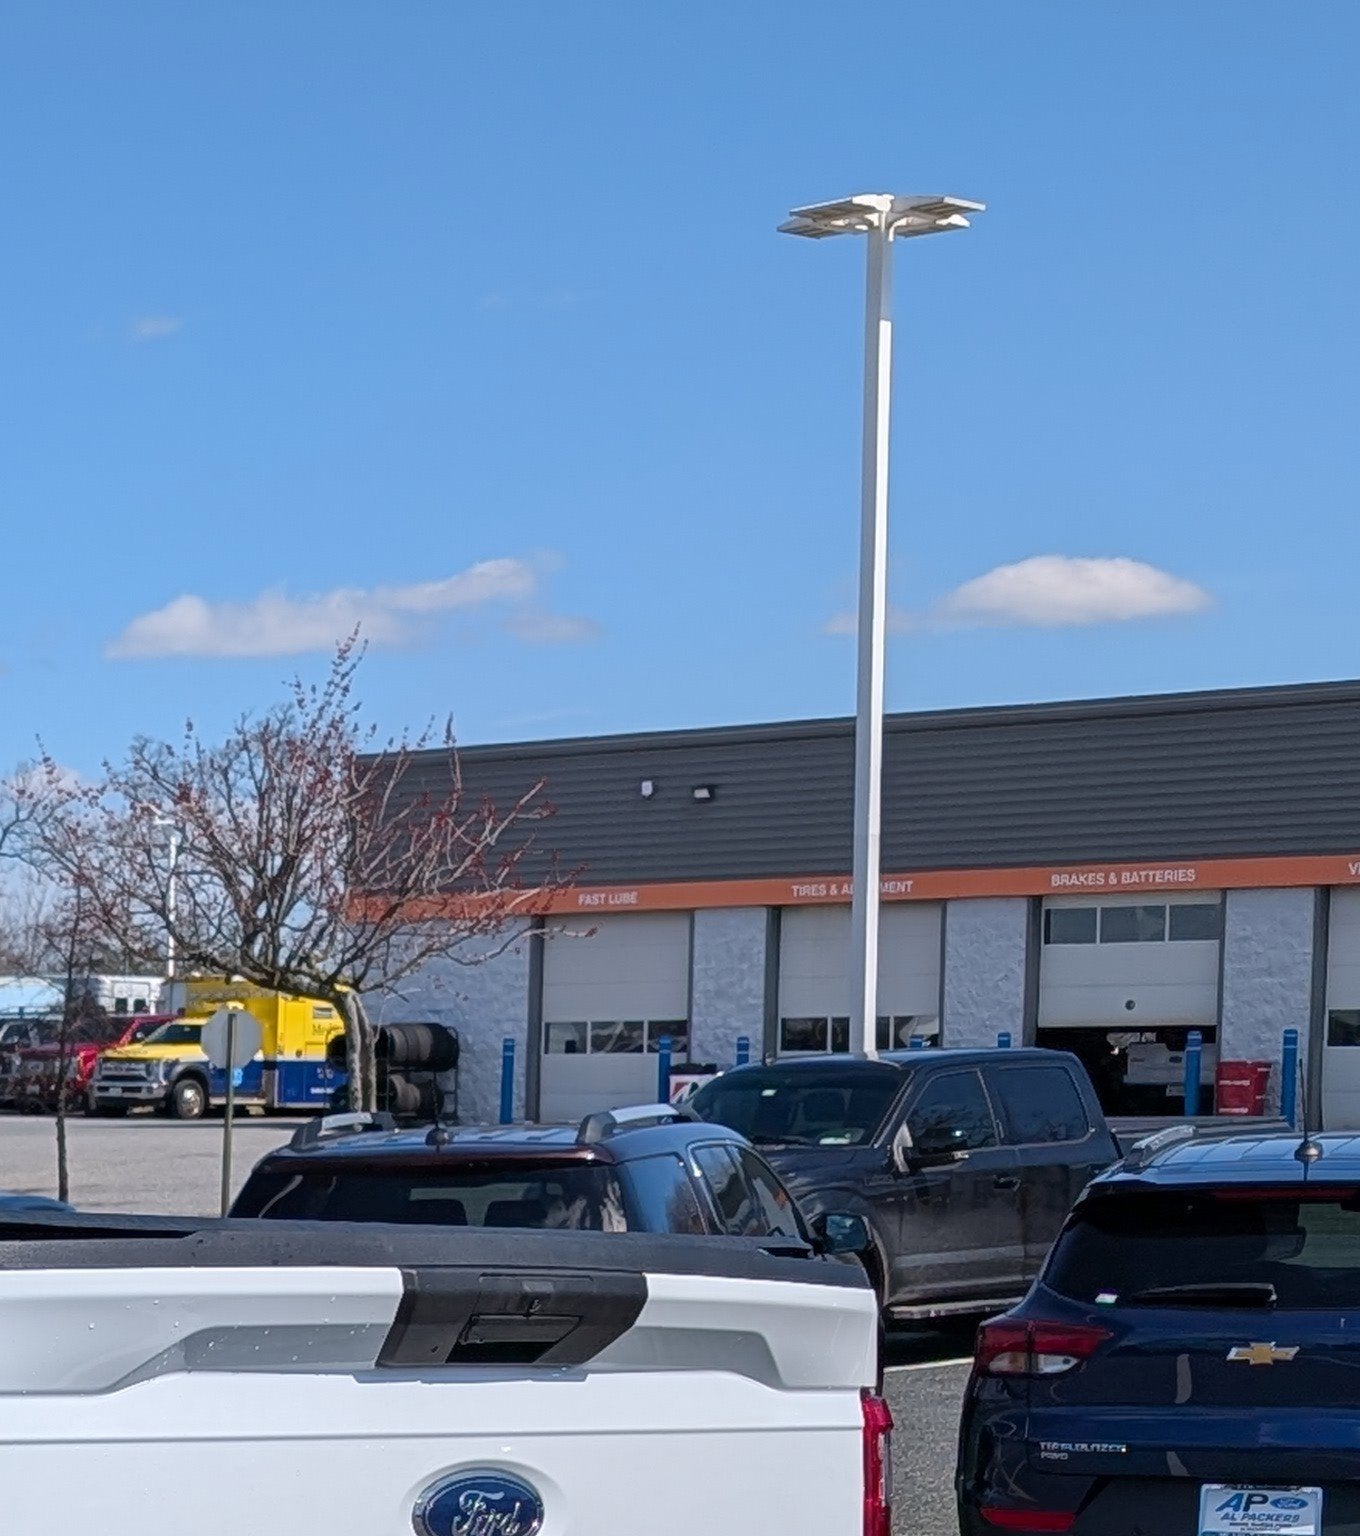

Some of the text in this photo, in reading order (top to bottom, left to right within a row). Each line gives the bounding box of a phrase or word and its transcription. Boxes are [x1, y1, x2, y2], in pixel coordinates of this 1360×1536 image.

[1051, 868, 1195, 887] BRAKES & BATTERIES
[791, 884, 827, 897] TIRES
[829, 884, 838, 895] &
[578, 891, 638, 906] FAST LUBE
[1215, 1493, 1269, 1512] AP
[1221, 1513, 1300, 1523] AL PACKERS
